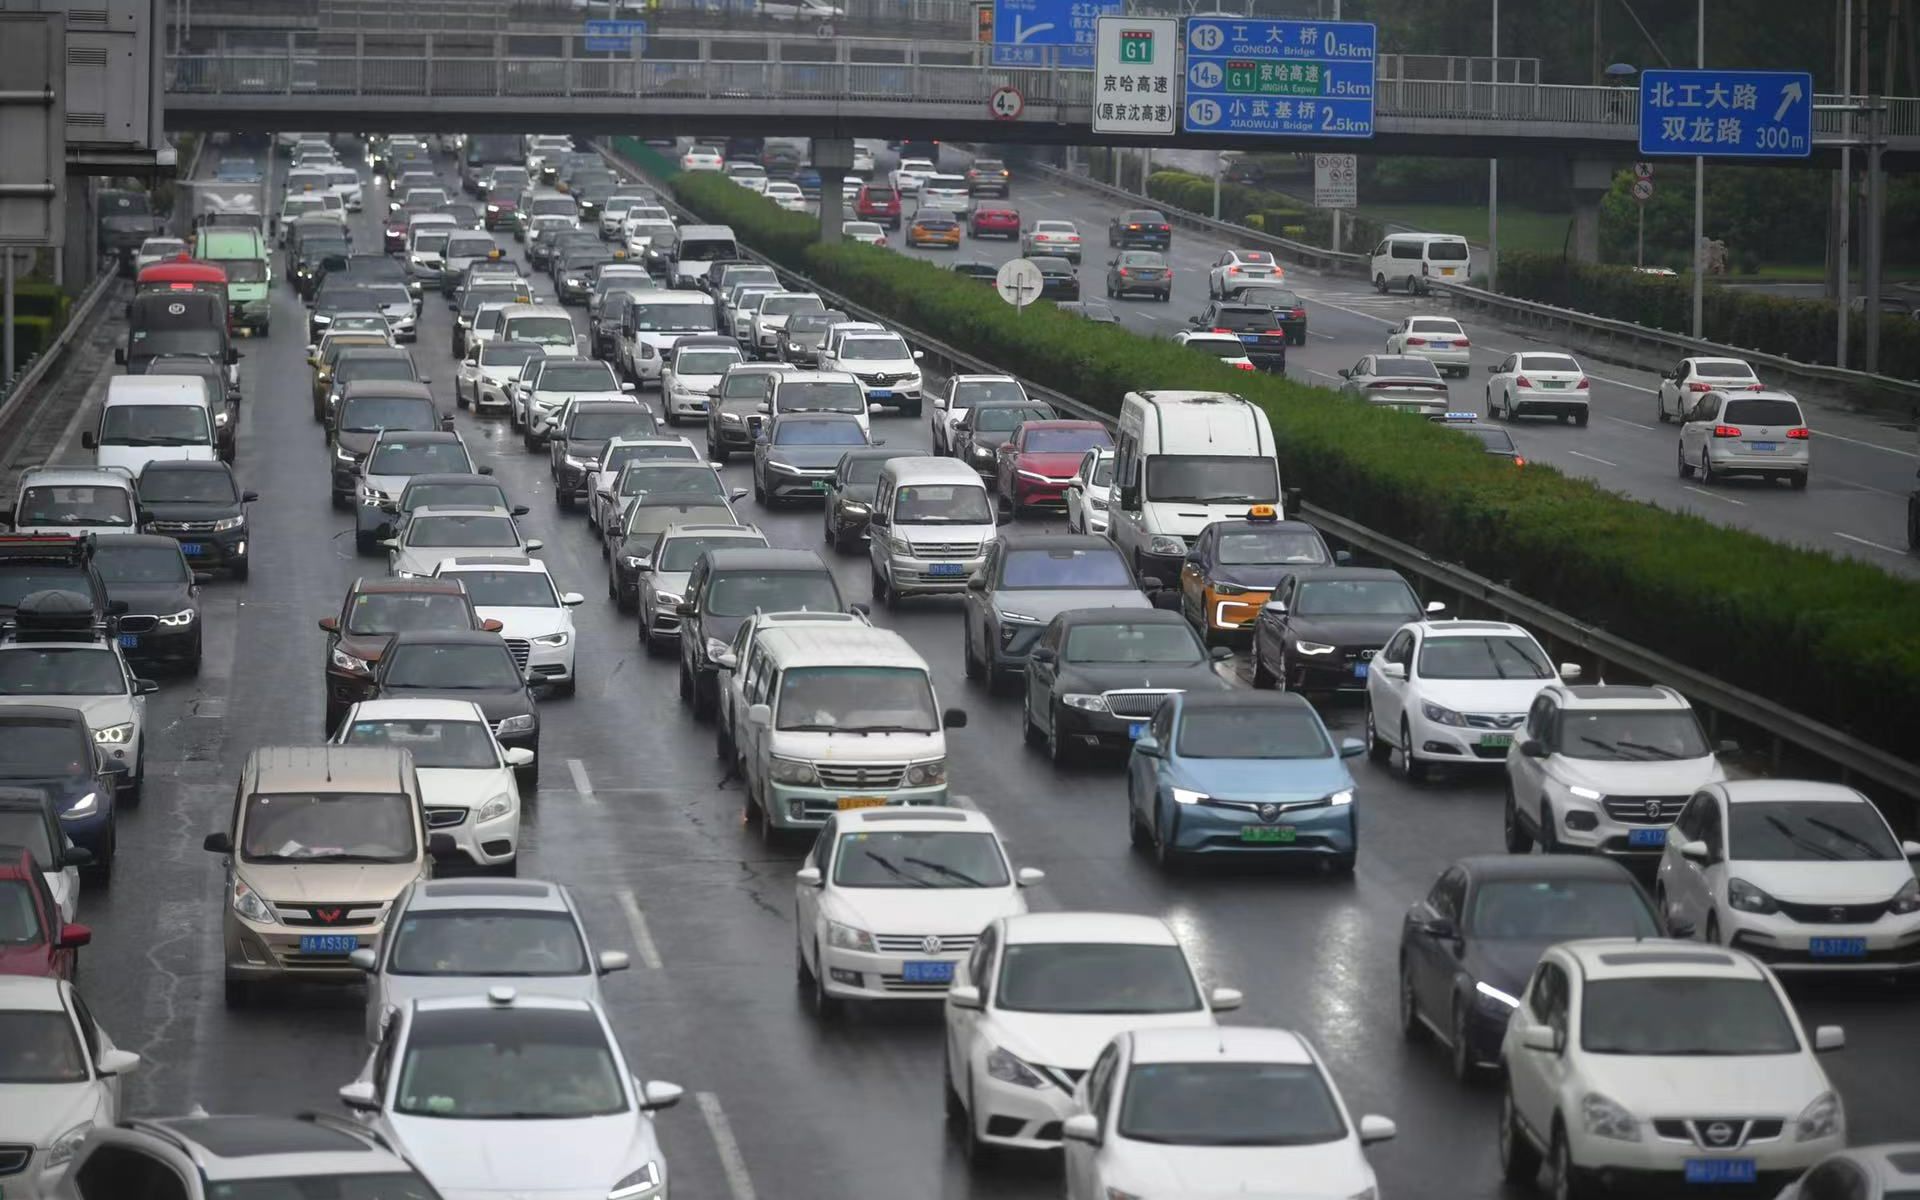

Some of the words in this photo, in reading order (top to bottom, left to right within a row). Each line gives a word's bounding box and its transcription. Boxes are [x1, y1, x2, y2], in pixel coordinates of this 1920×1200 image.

[1199, 28, 1216, 46] 13
[1232, 25, 1318, 45] 工大桥
[1324, 31, 1372, 57] 0.5km
[1126, 42, 1147, 60] G1
[1233, 45, 1279, 54] GONGDA
[1284, 46, 1315, 57] Bridge
[1103, 75, 1168, 93] 京哈高速
[1193, 66, 1218, 84] 14B
[1232, 72, 1251, 87] G1
[1260, 64, 1319, 83] 京哈高速
[1323, 69, 1371, 95] 1.5km
[1260, 84, 1289, 93] JINGHA
[1650, 82, 1758, 110] 北工大路
[1196, 103, 1213, 121] 15
[1229, 99, 1316, 119] 小武基桥
[1322, 106, 1370, 132] 2.5km
[1230, 119, 1279, 129] XIAOWUJI
[1283, 121, 1313, 131] Bridge
[1661, 116, 1742, 144] 双龙路
[1756, 127, 1803, 149] 300m
